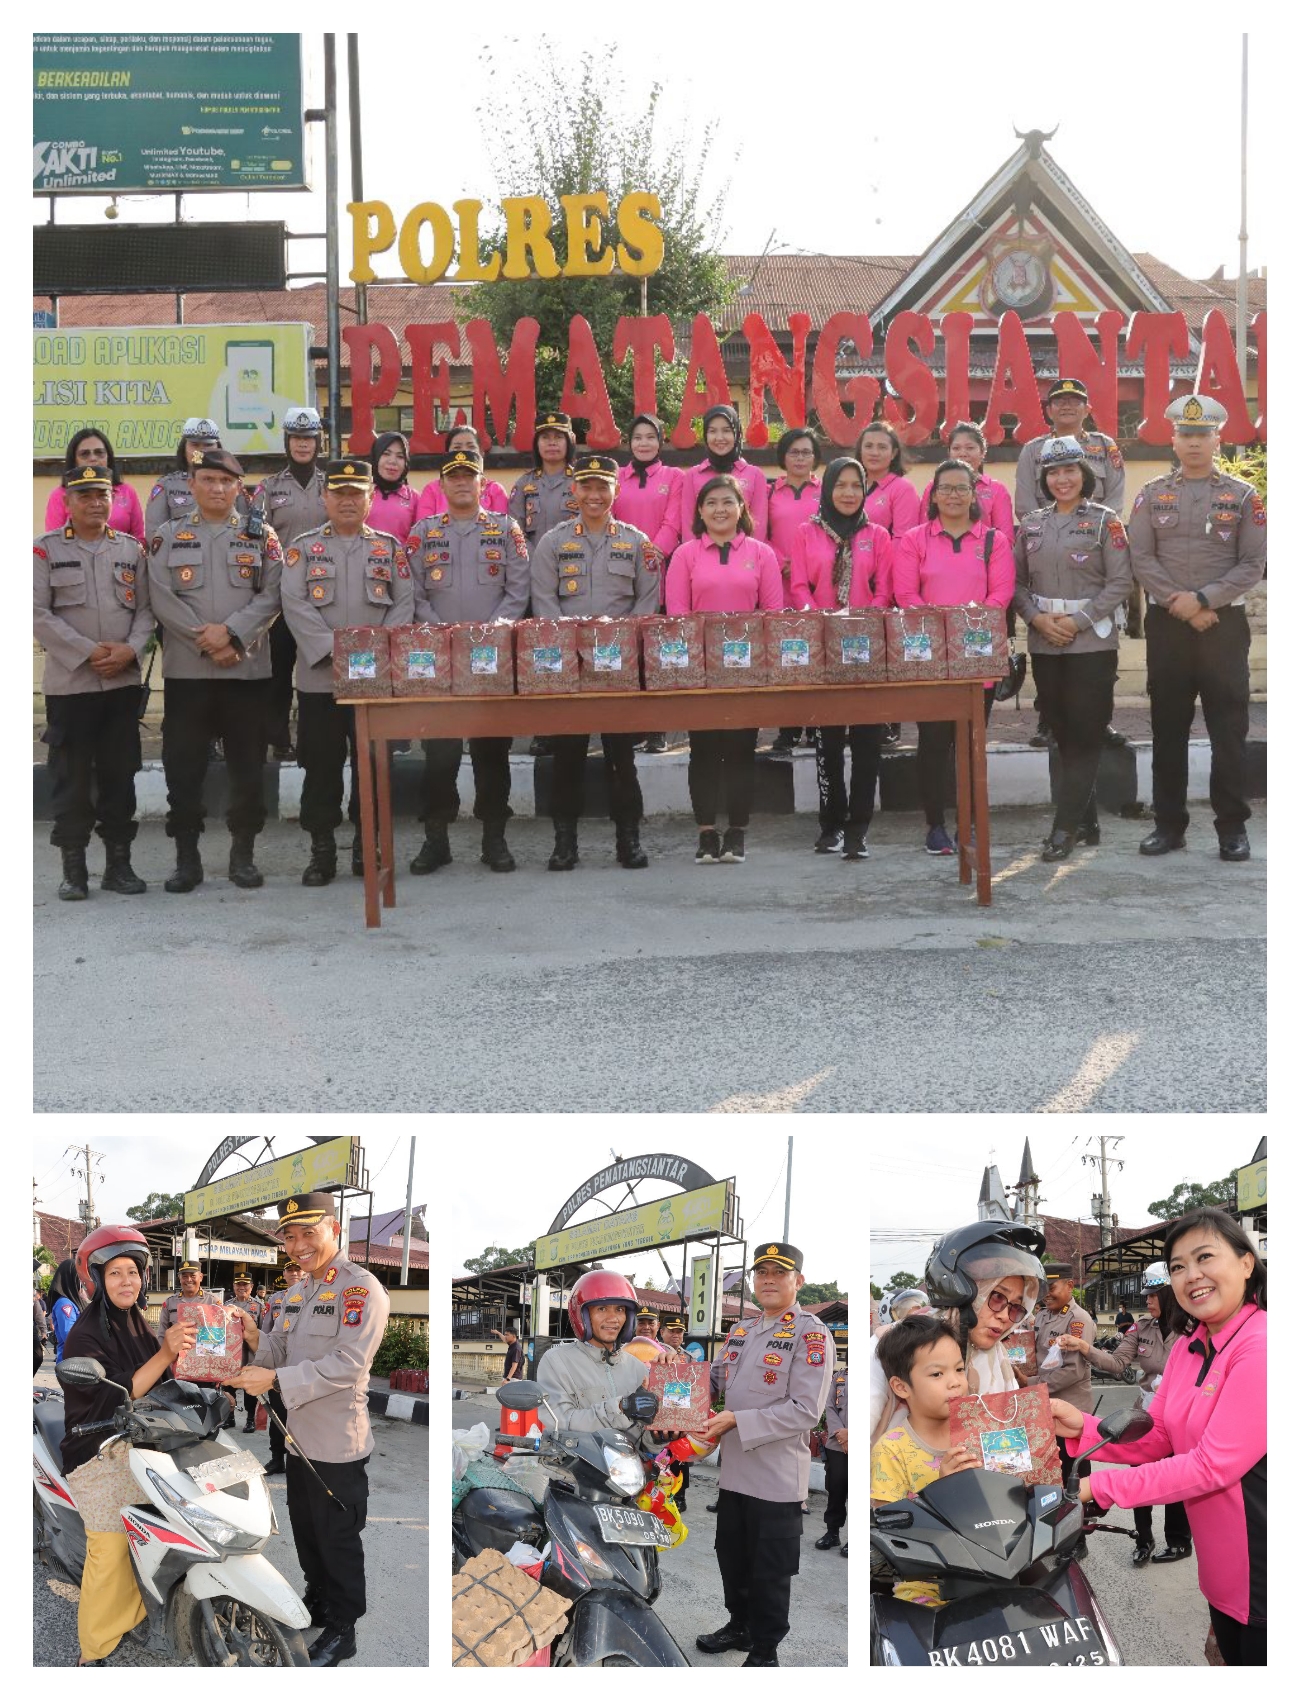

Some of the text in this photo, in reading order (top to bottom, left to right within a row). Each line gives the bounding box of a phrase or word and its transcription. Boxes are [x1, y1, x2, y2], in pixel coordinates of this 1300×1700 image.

[38, 71, 131, 87] BERKEADILAN
[52, 140, 85, 149] COMBO
[179, 146, 226, 157] Youtube,
[43, 167, 117, 189] Unlimited
[346, 191, 665, 285] POLRES
[33, 335, 206, 366] OAD APLIKASI
[94, 379, 171, 405] KITA
[207, 1137, 234, 1176] POLRES
[562, 1157, 689, 1221] POLRES PEMATANGSIANTAR
[219, 1245, 250, 1255] MELAYANI
[313, 1305, 335, 1315] POLRI
[766, 1340, 794, 1352] POLRI
[128, 1515, 151, 1539] HONDA
[598, 1507, 617, 1524] BK
[614, 1509, 645, 1527] 5090
[974, 1518, 1016, 1530] HONDA
[967, 1631, 1032, 1666] 4081
[1039, 1617, 1091, 1648] WAF
